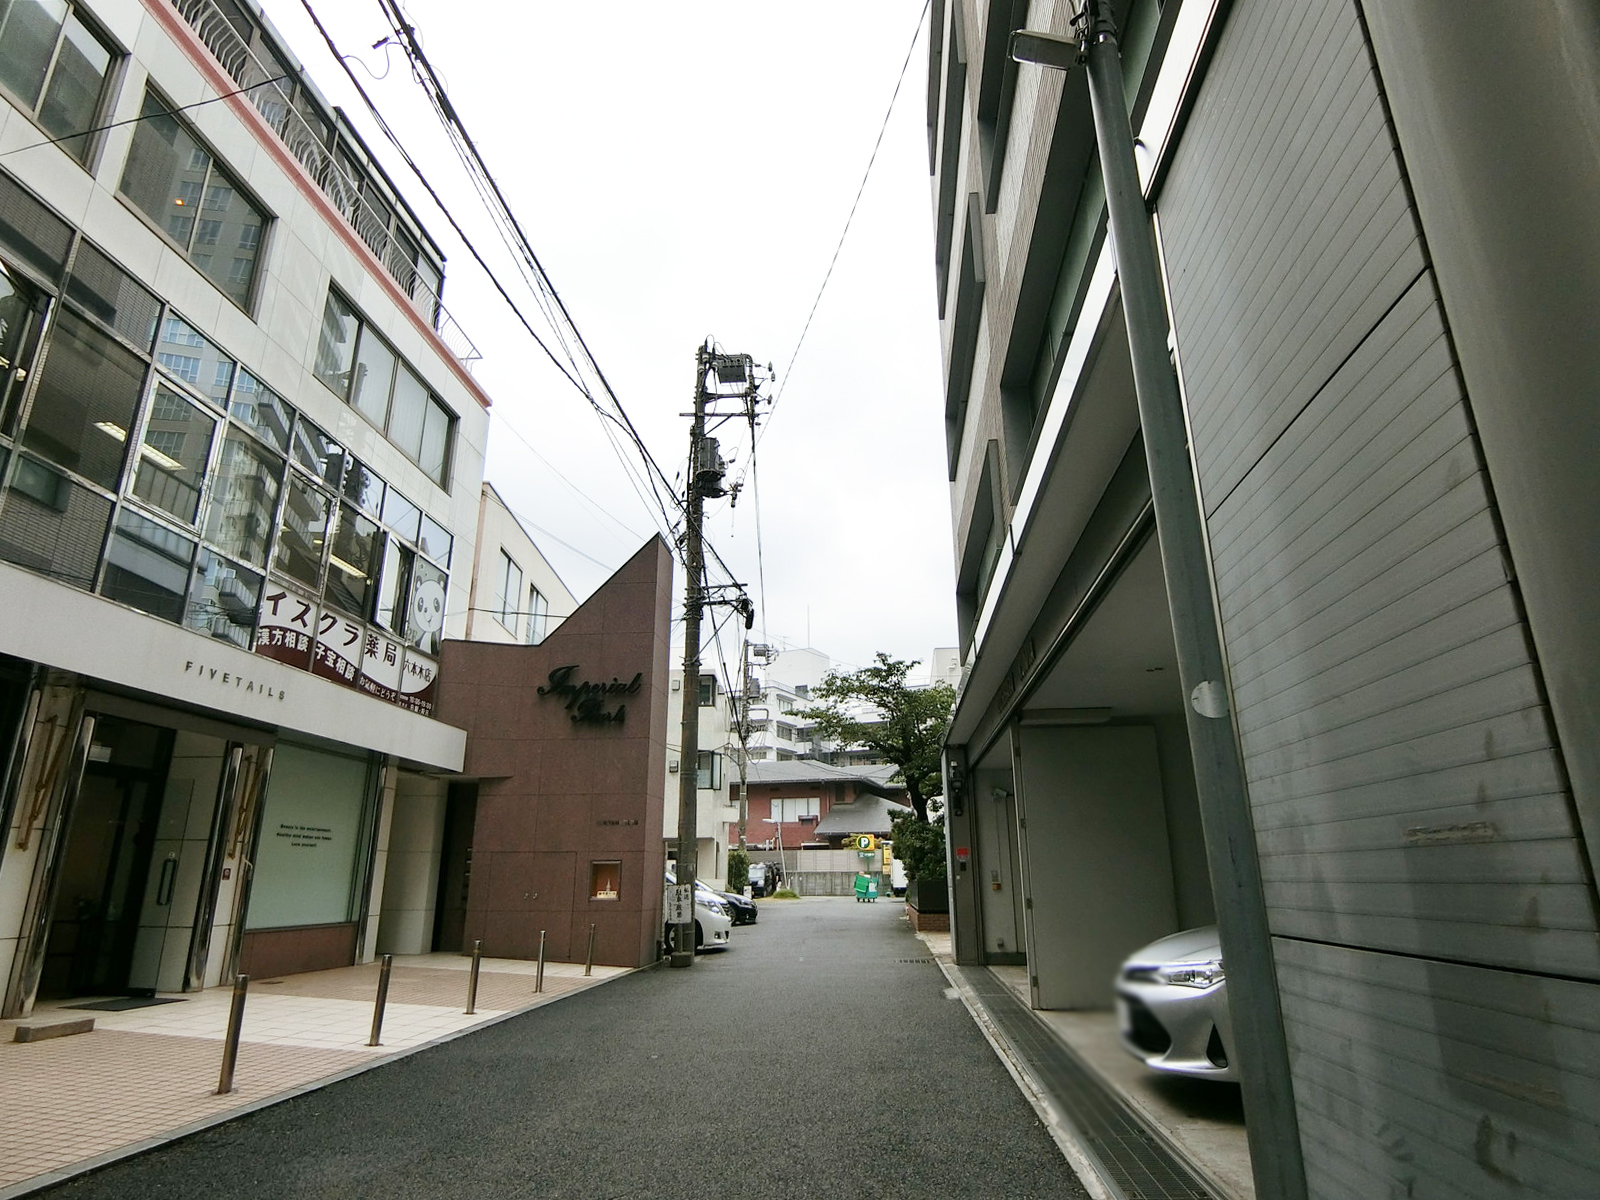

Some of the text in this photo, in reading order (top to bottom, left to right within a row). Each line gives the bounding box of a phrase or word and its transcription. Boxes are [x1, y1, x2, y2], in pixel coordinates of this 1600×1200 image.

[257, 627, 308, 653] 漢方相談
[315, 641, 355, 682] 子宝相談
[403, 659, 432, 683] 六本木店
[185, 660, 285, 700] FIVETAILS
[359, 675, 397, 702] お気軽にどうぞ
[537, 664, 643, 710] Imperial
[571, 699, 626, 724] Park
[860, 837, 869, 848] P
